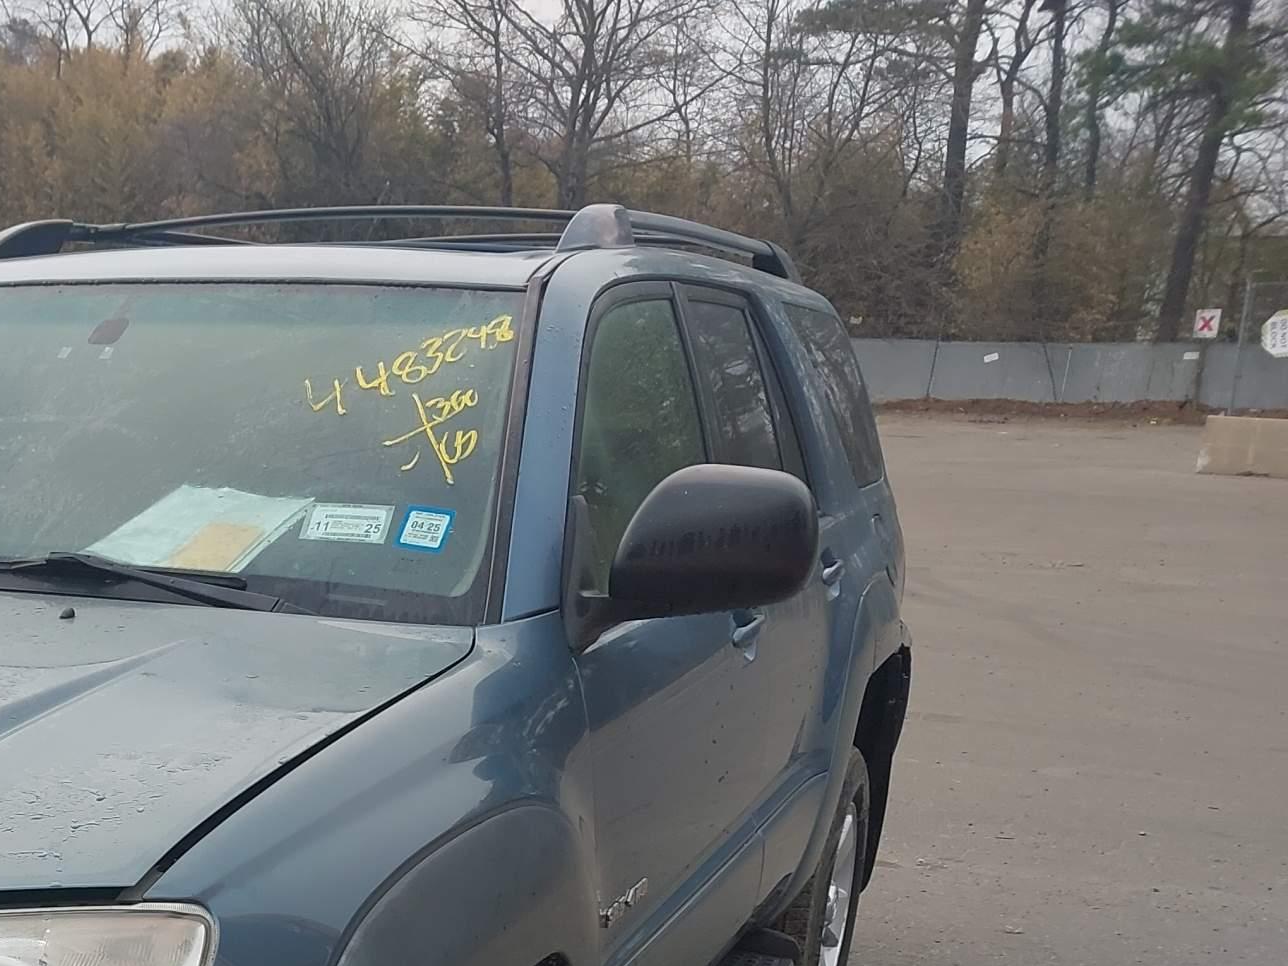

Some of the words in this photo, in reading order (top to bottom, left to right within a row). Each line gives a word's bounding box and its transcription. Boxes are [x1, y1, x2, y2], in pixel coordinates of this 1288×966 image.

[315, 520, 330, 532] 11
[364, 523, 382, 534] 25
[410, 520, 425, 530] 04
[426, 522, 442, 532] 25
